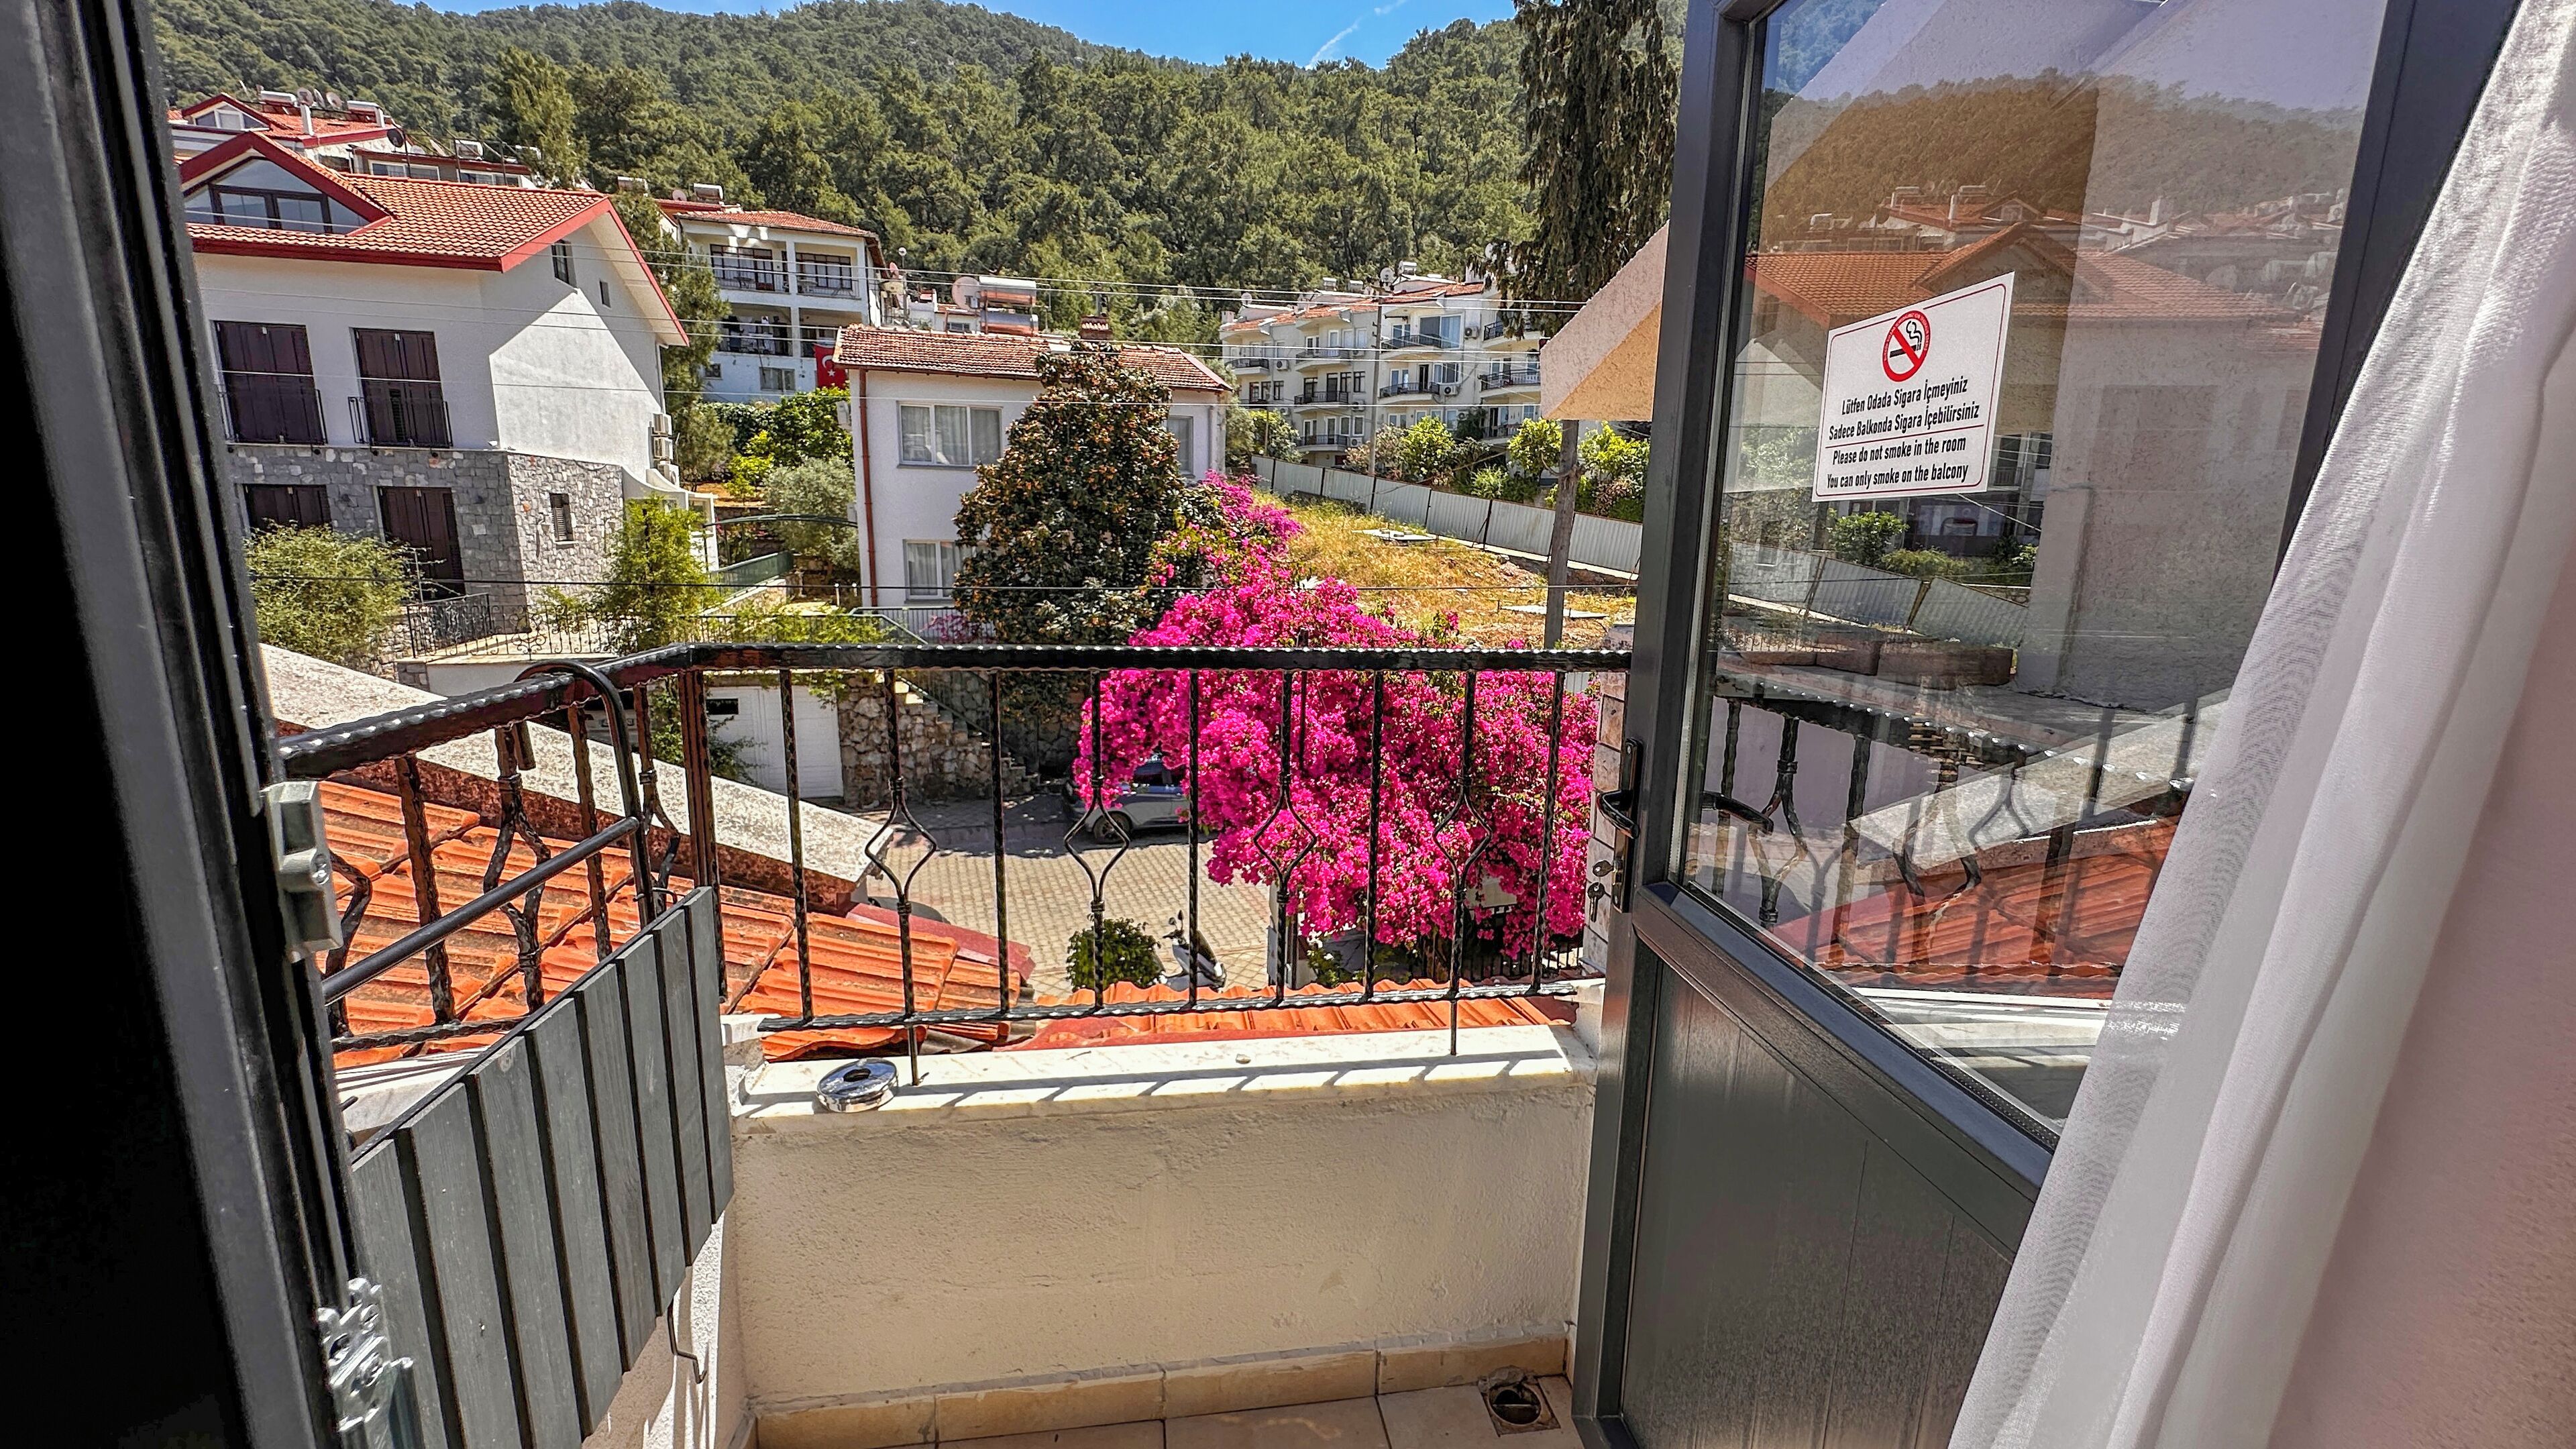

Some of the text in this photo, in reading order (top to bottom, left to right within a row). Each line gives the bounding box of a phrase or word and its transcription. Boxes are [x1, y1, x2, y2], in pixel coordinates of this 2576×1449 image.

[1842, 376, 1968, 415] Lütfen Odada Sigara İçmeyiniz
[1829, 401, 1980, 440] Sadece Balkonda Sigara İçebilirsiniz
[1833, 437, 1966, 465] Please do not smoke in the room
[1827, 462, 1968, 490] You can only smoke on the balcony
